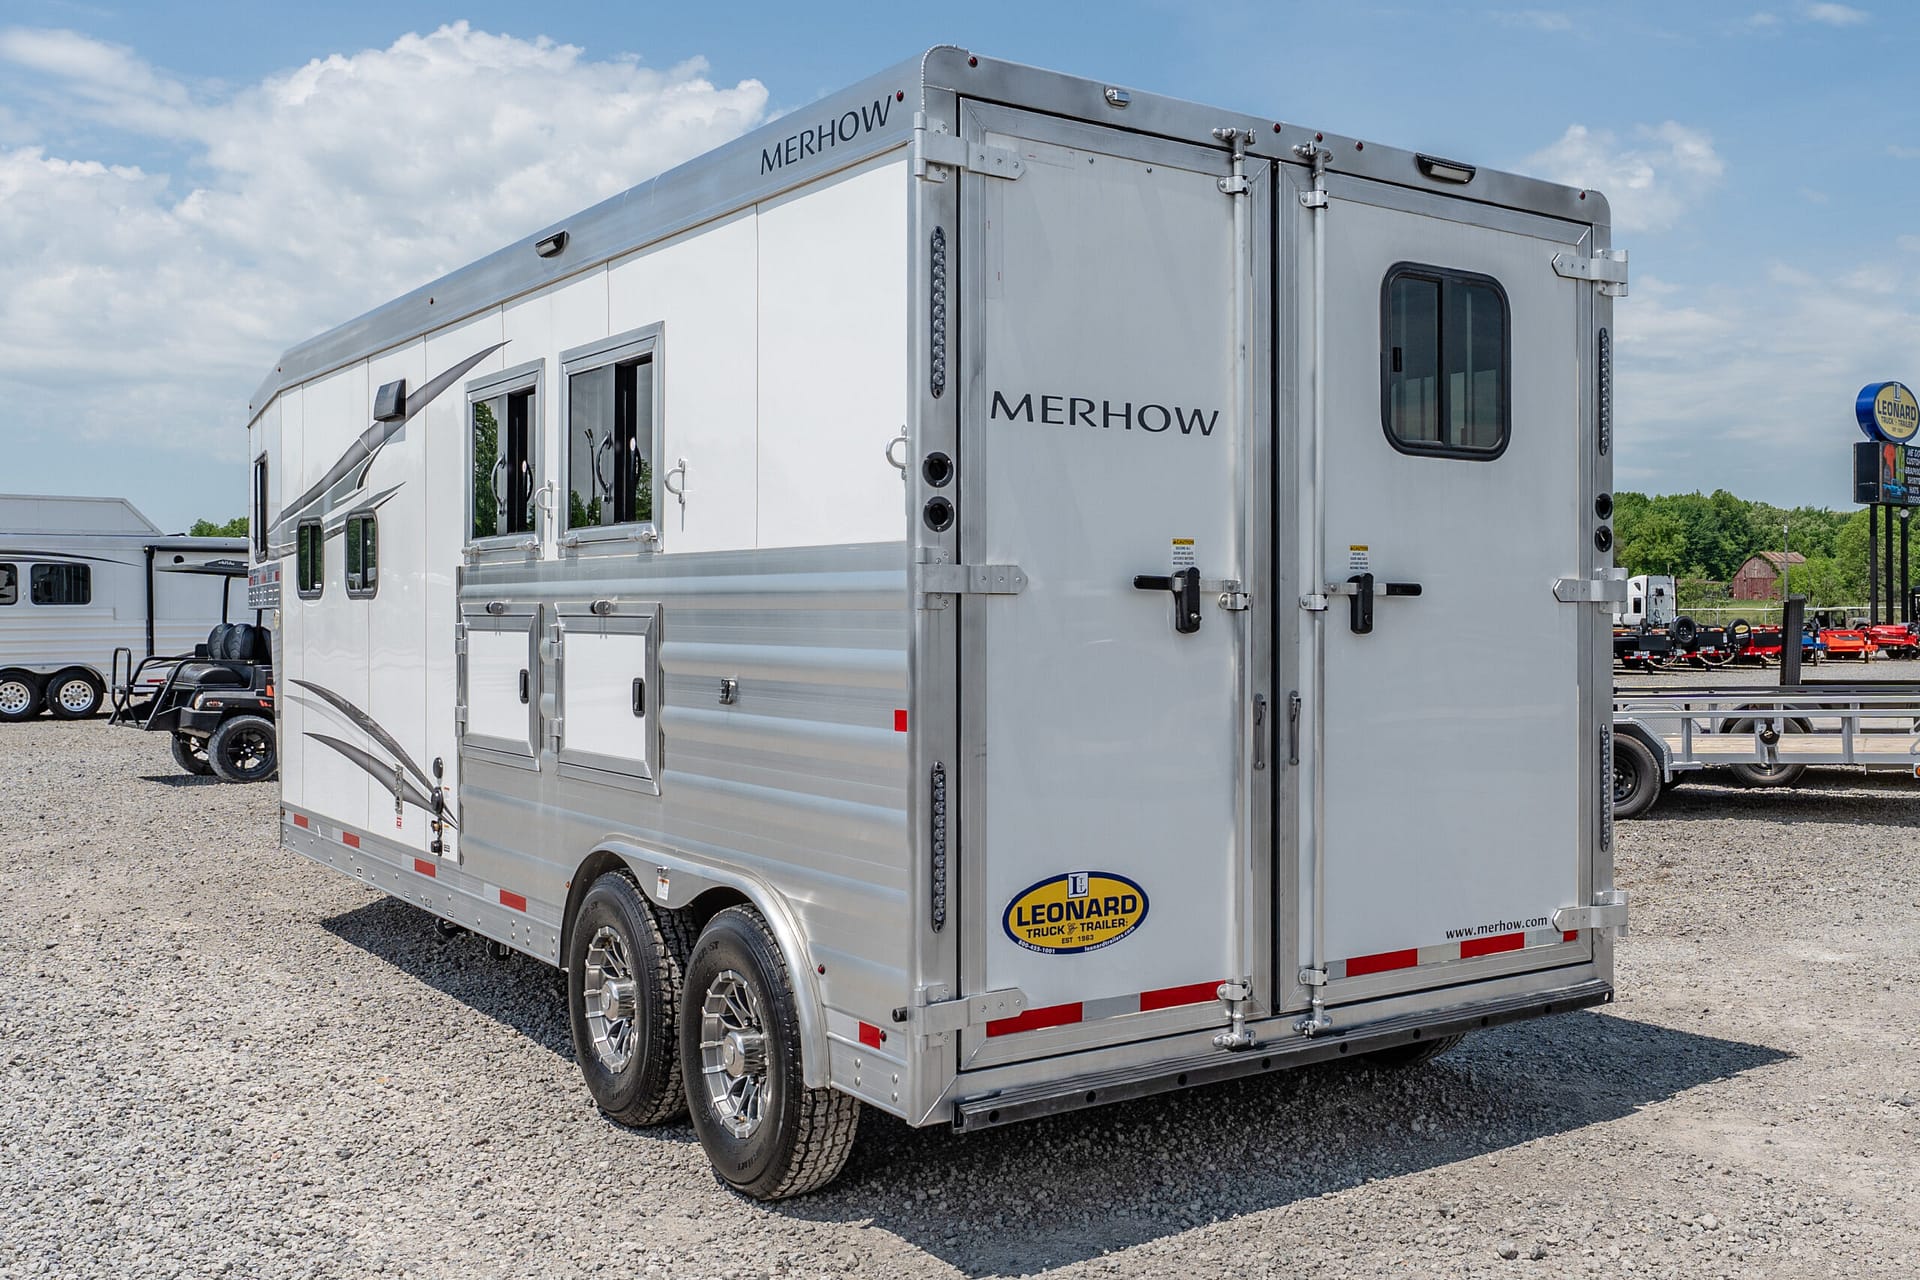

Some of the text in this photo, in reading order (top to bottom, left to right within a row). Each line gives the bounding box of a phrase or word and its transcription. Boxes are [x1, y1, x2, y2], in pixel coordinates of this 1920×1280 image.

[760, 94, 892, 176] MERHOW
[990, 390, 1219, 437] MERHOW
[1877, 399, 1917, 422] LEONARD
[1016, 894, 1138, 927] LEONARD
[1026, 924, 1065, 939] TRUCK
[1080, 918, 1125, 932] TRAILER
[1445, 916, 1548, 939] www.merhow.com
